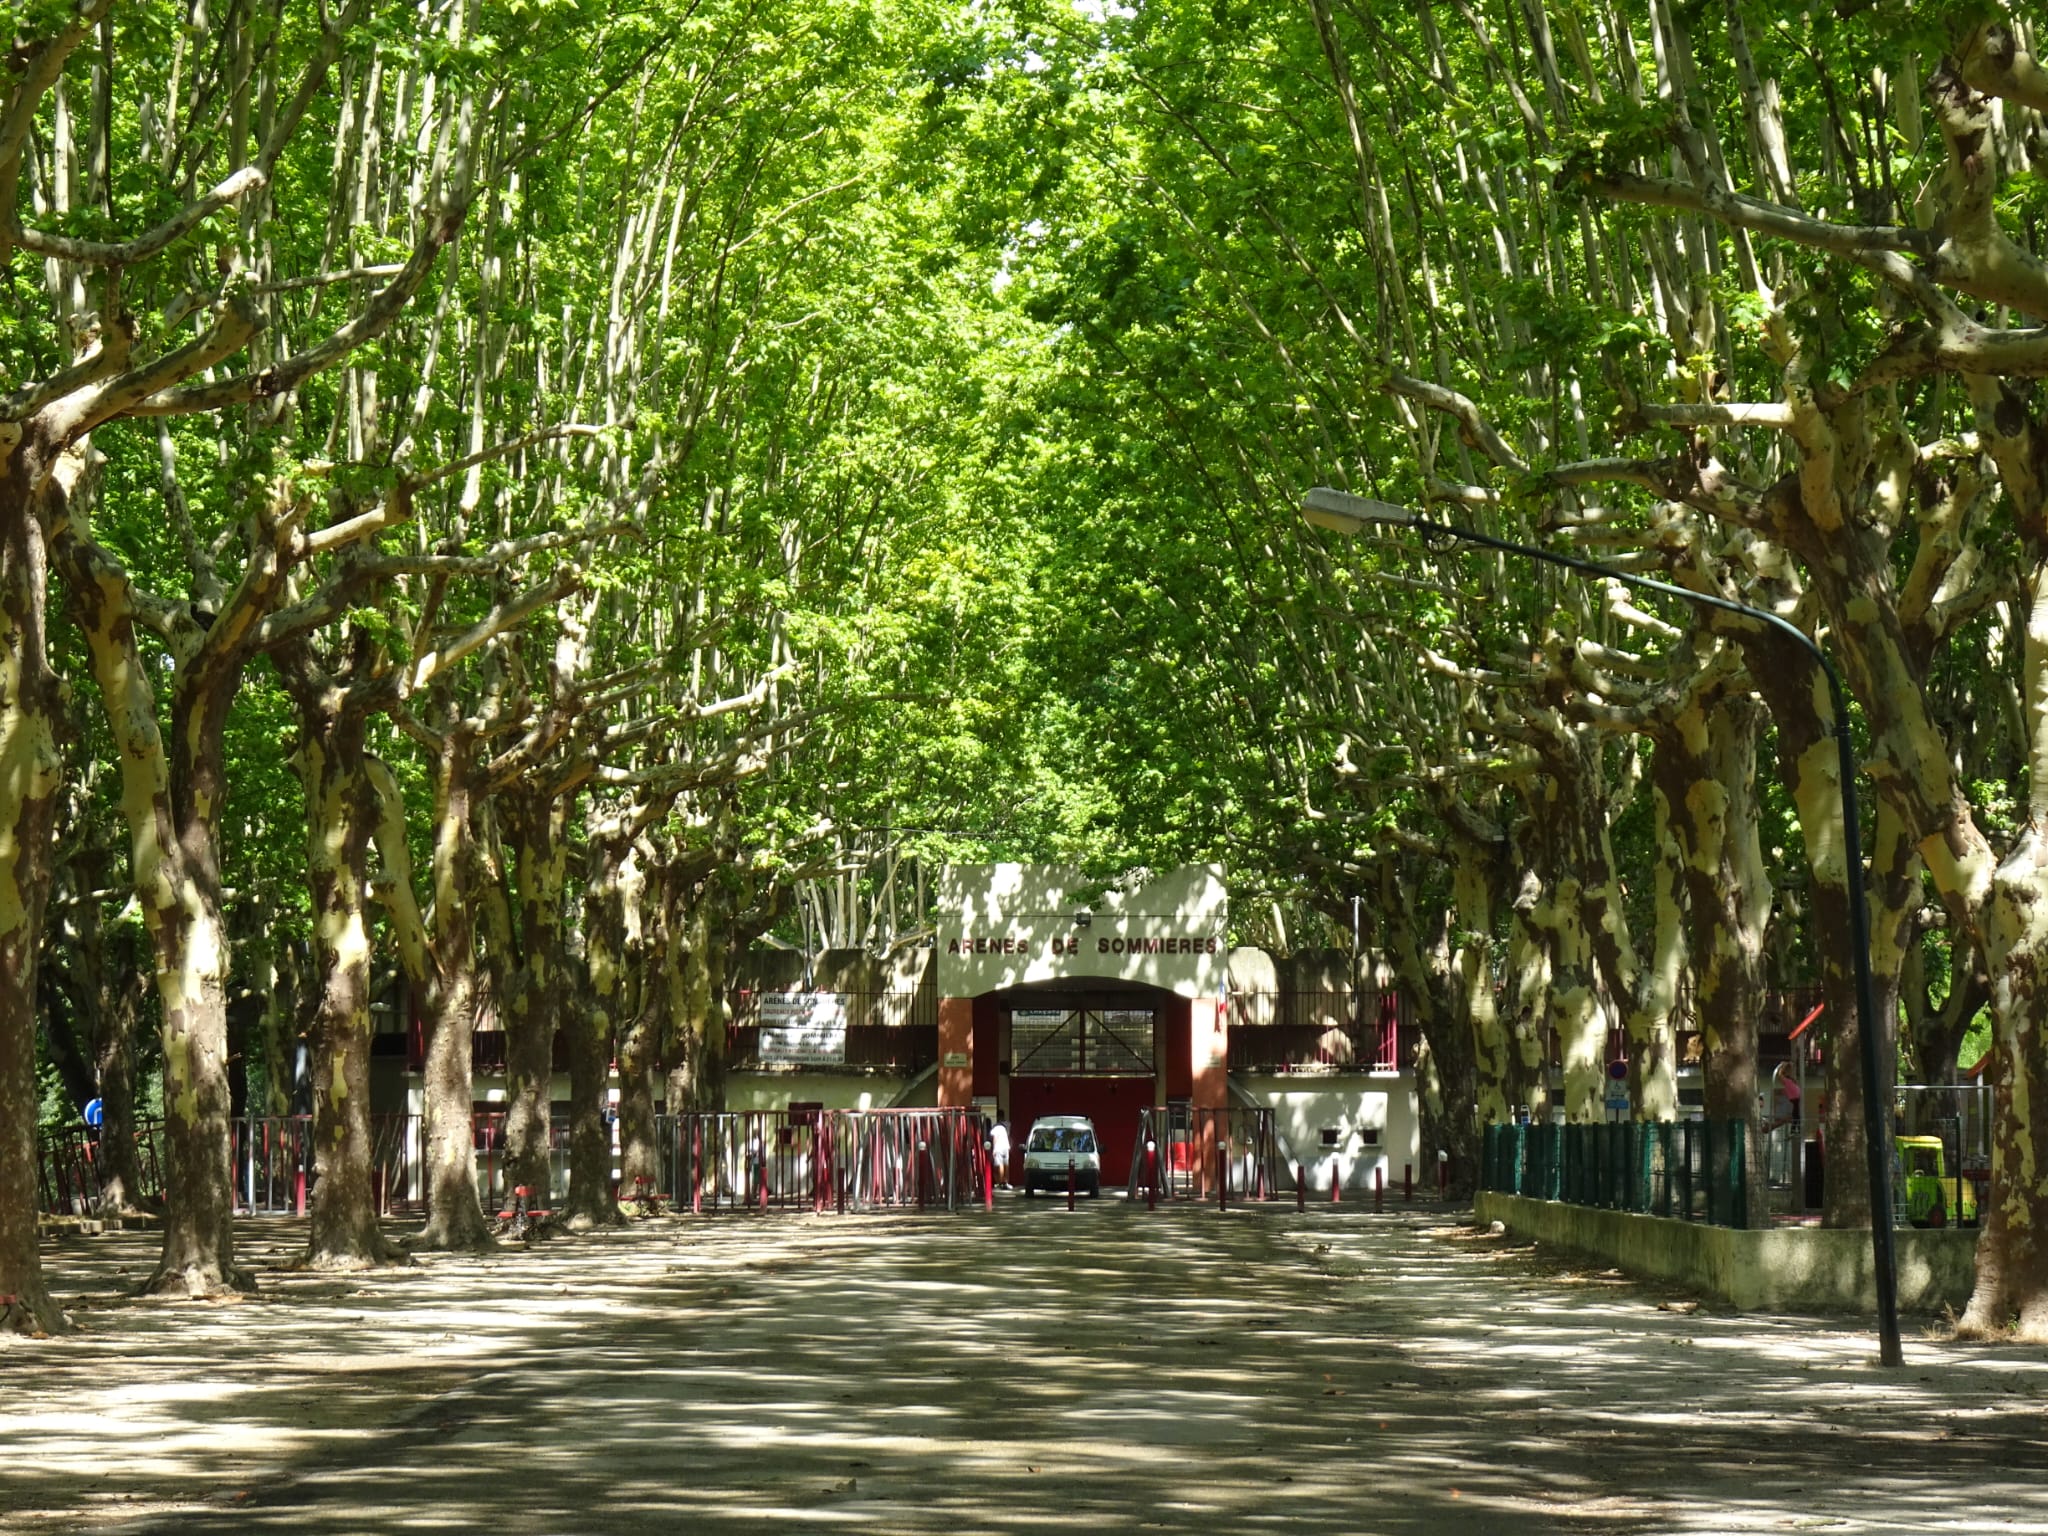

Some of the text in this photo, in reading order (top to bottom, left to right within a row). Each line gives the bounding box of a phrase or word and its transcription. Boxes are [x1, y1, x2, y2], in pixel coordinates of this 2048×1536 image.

[948, 938, 1217, 955] ARENES DE SOMMIERES
